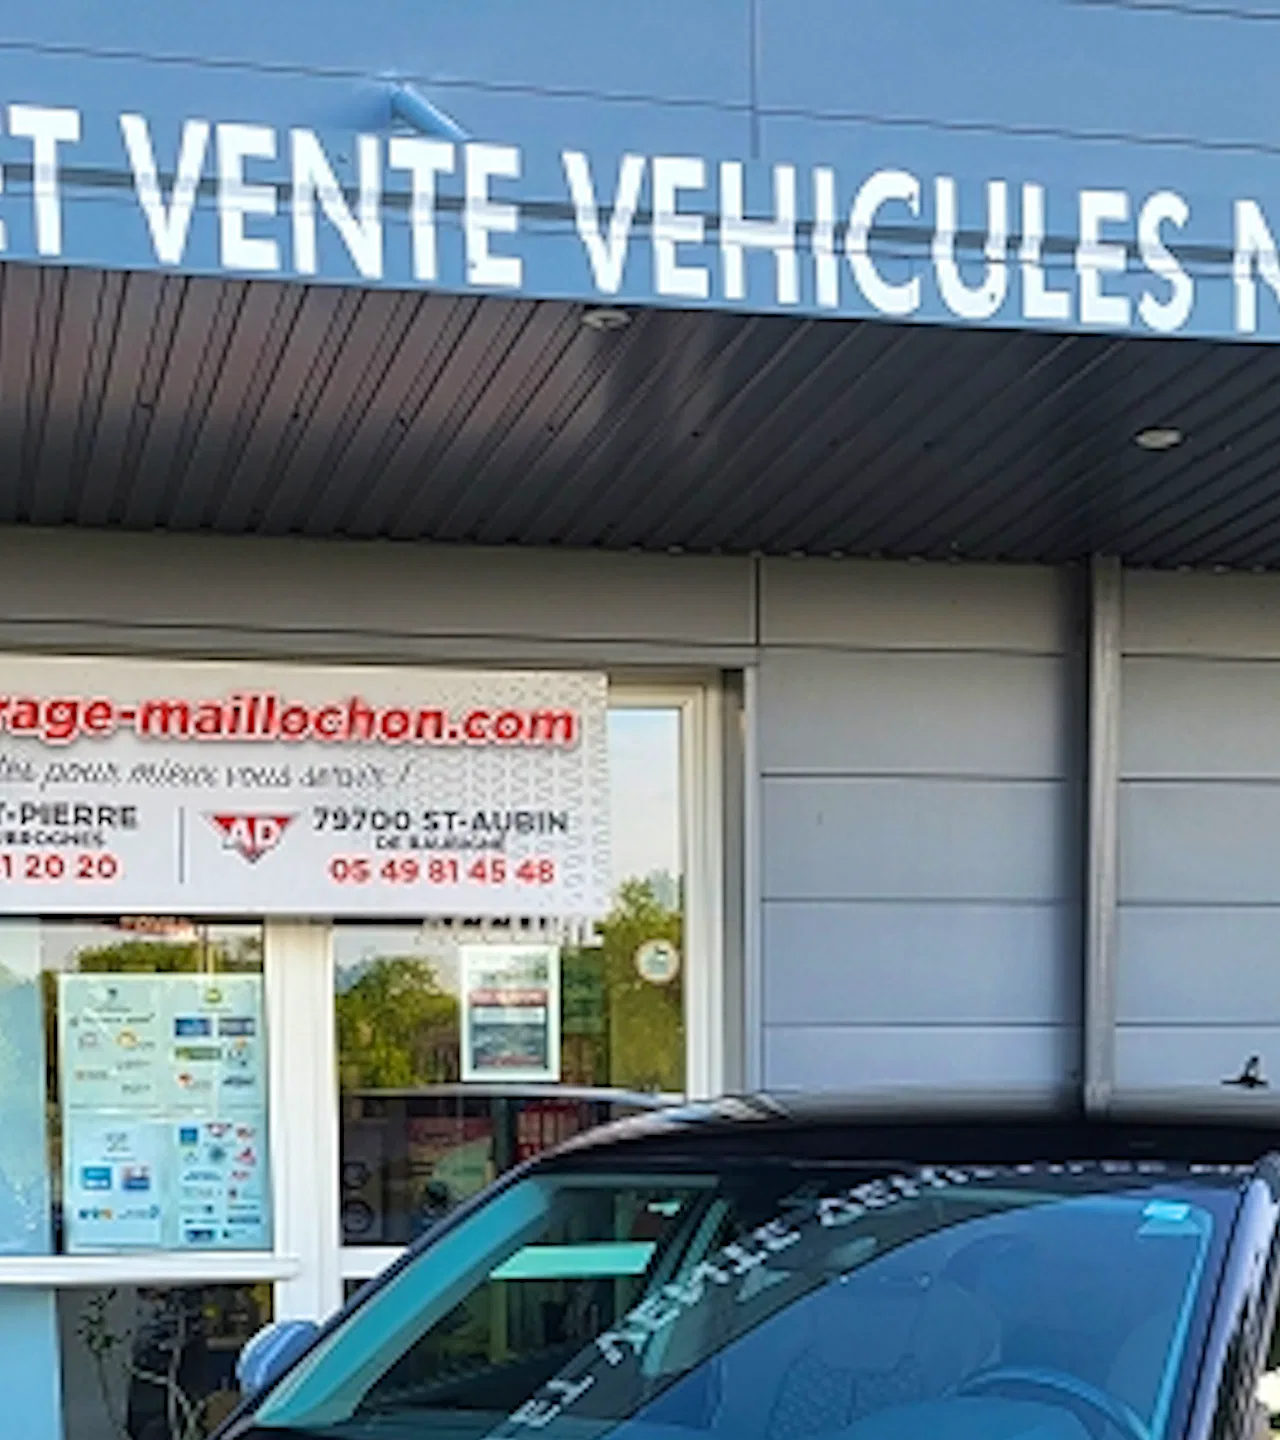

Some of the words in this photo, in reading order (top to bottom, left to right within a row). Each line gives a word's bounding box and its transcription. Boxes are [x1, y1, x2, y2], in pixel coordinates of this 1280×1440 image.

[120, 112, 521, 288] VENTE
[562, 150, 1195, 334] VEHICULES
[312, 806, 411, 832] 79700
[421, 810, 570, 833] ST-AUBIN
[24, 853, 66, 880] 20
[74, 854, 119, 880] 20
[328, 858, 371, 884] 05
[380, 858, 420, 884] 49
[428, 859, 460, 885] 81
[468, 859, 507, 885] 45
[516, 859, 556, 885] 48
